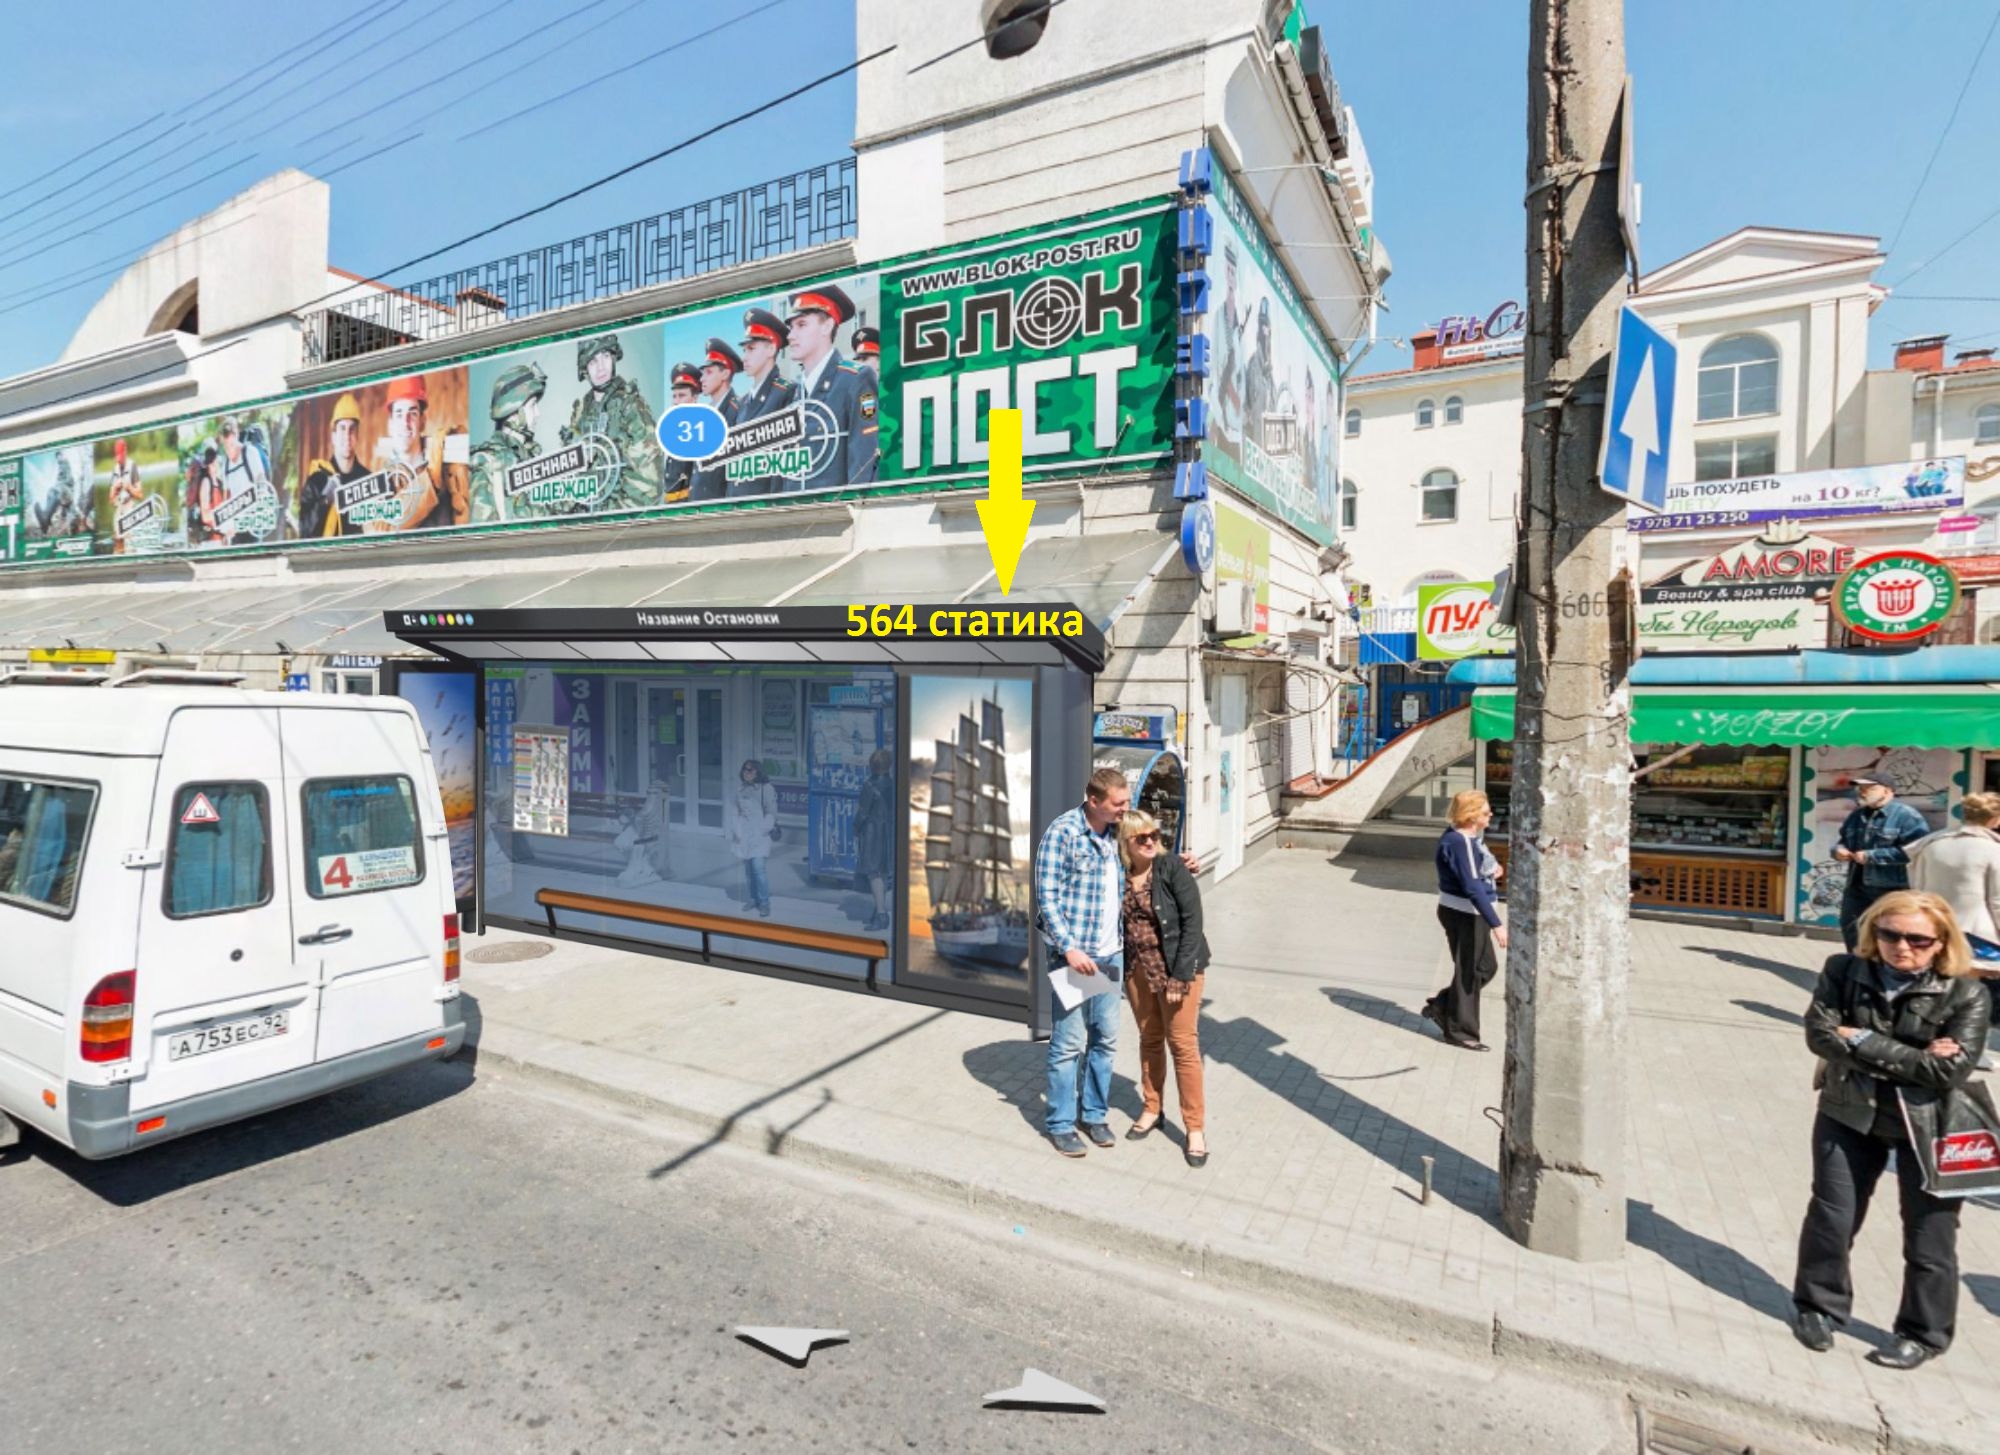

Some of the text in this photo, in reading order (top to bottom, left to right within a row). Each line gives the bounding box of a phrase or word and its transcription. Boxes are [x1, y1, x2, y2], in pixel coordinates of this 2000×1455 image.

[903, 229, 1140, 297] WWW.BLOK-POST.RU
[902, 264, 1140, 366] БЛОК
[903, 346, 1138, 469] ПОСТ
[717, 417, 797, 457] РМЕННАЯ
[513, 450, 579, 488] ВОЕННАЯ
[728, 450, 811, 478] ОДЕЖДА
[344, 478, 379, 505] СПЕЦ
[532, 478, 597, 502] ОДЕЖДА
[1693, 479, 1781, 496] ПОХУДЕТЬ
[1792, 486, 1880, 503] на 10 кг?
[350, 500, 403, 522] ОДЕЖДА
[1645, 515, 1671, 529] 978
[1674, 514, 1692, 527] 71
[1696, 513, 1716, 525] 25
[1718, 510, 1749, 523] 250
[1701, 547, 1856, 582] AMORE
[1657, 584, 1806, 601] Beauty & spa club
[1846, 559, 1891, 610] ДРУЖБА
[636, 611, 780, 625] Название Остановки
[1681, 608, 1801, 642] Народов
[1882, 623, 1908, 632] ТМ
[571, 678, 592, 793] ЗАЙМЫ
[323, 856, 353, 889] 4
[180, 1014, 282, 1055] А753ЕС 92
